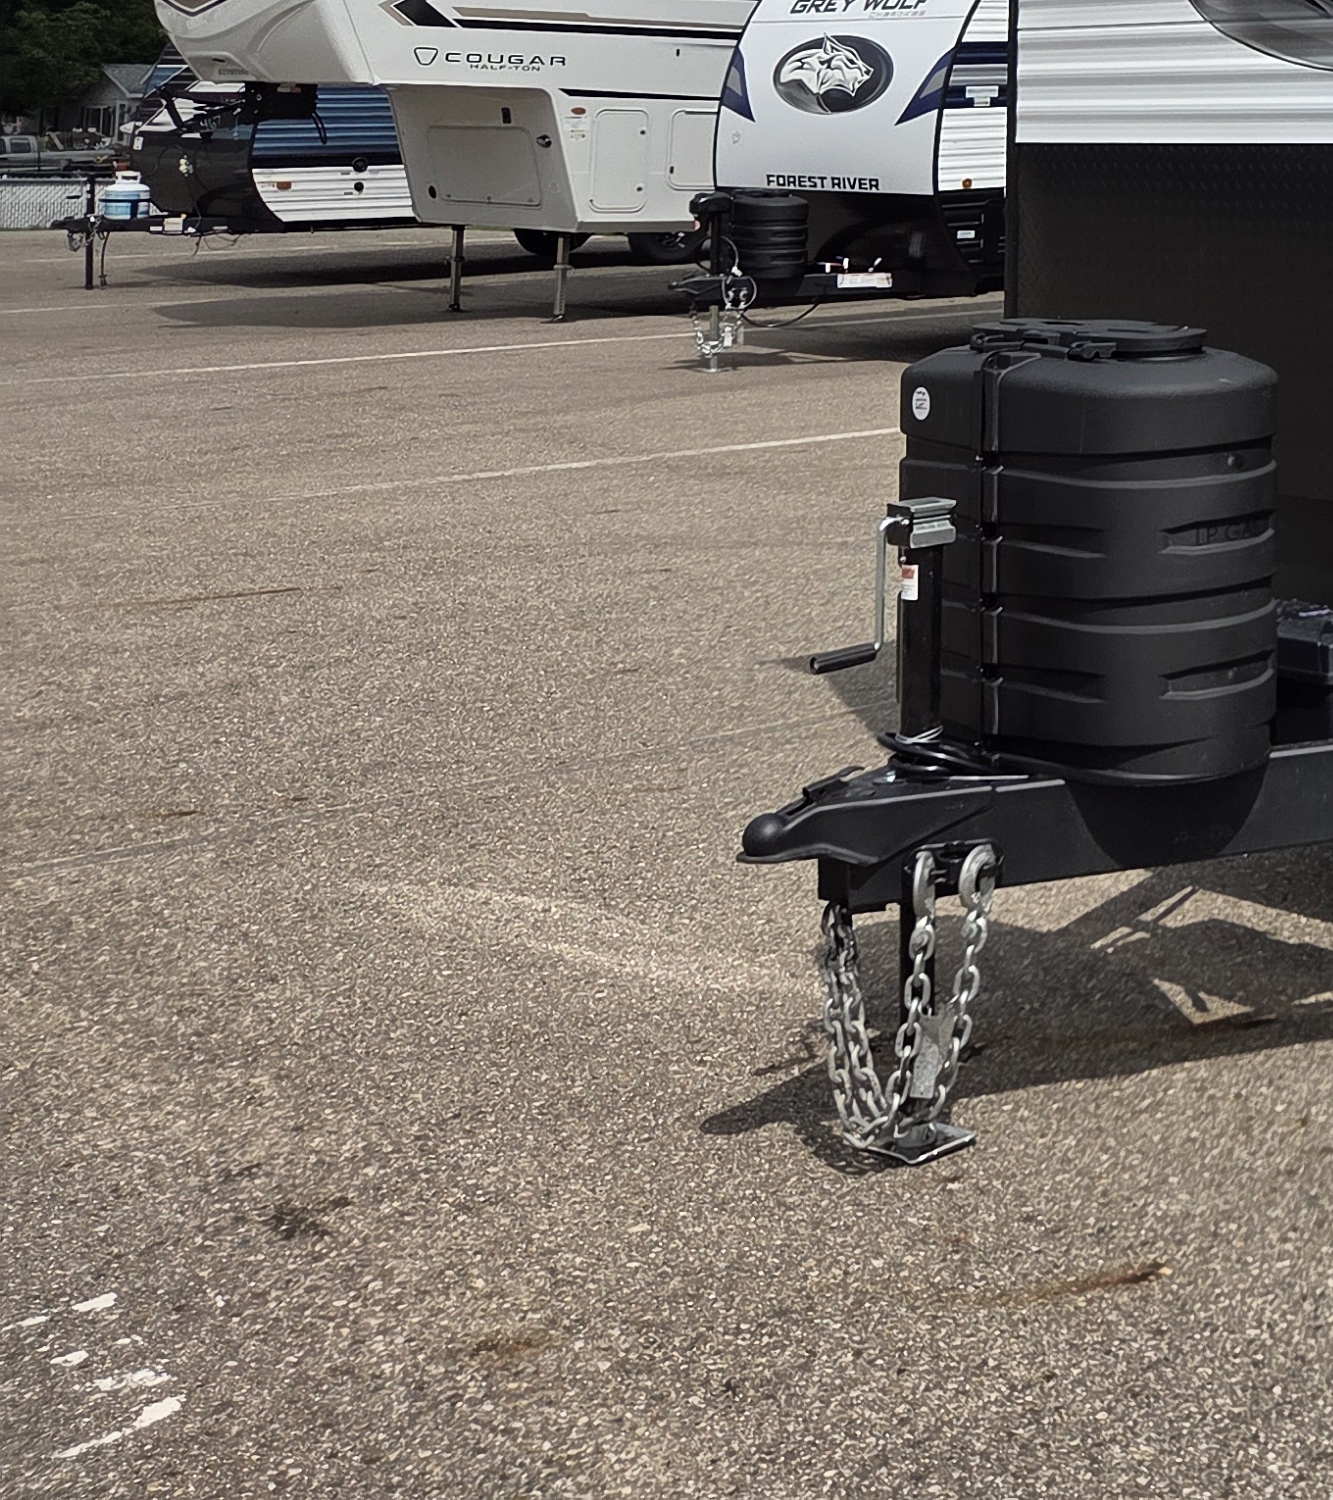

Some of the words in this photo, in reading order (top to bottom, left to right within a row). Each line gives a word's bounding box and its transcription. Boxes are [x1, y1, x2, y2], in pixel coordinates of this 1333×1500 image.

[445, 52, 566, 66] COUGAR
[470, 64, 540, 72] HALF-TON
[766, 174, 827, 188] FOREST
[830, 176, 880, 190] RIVER
